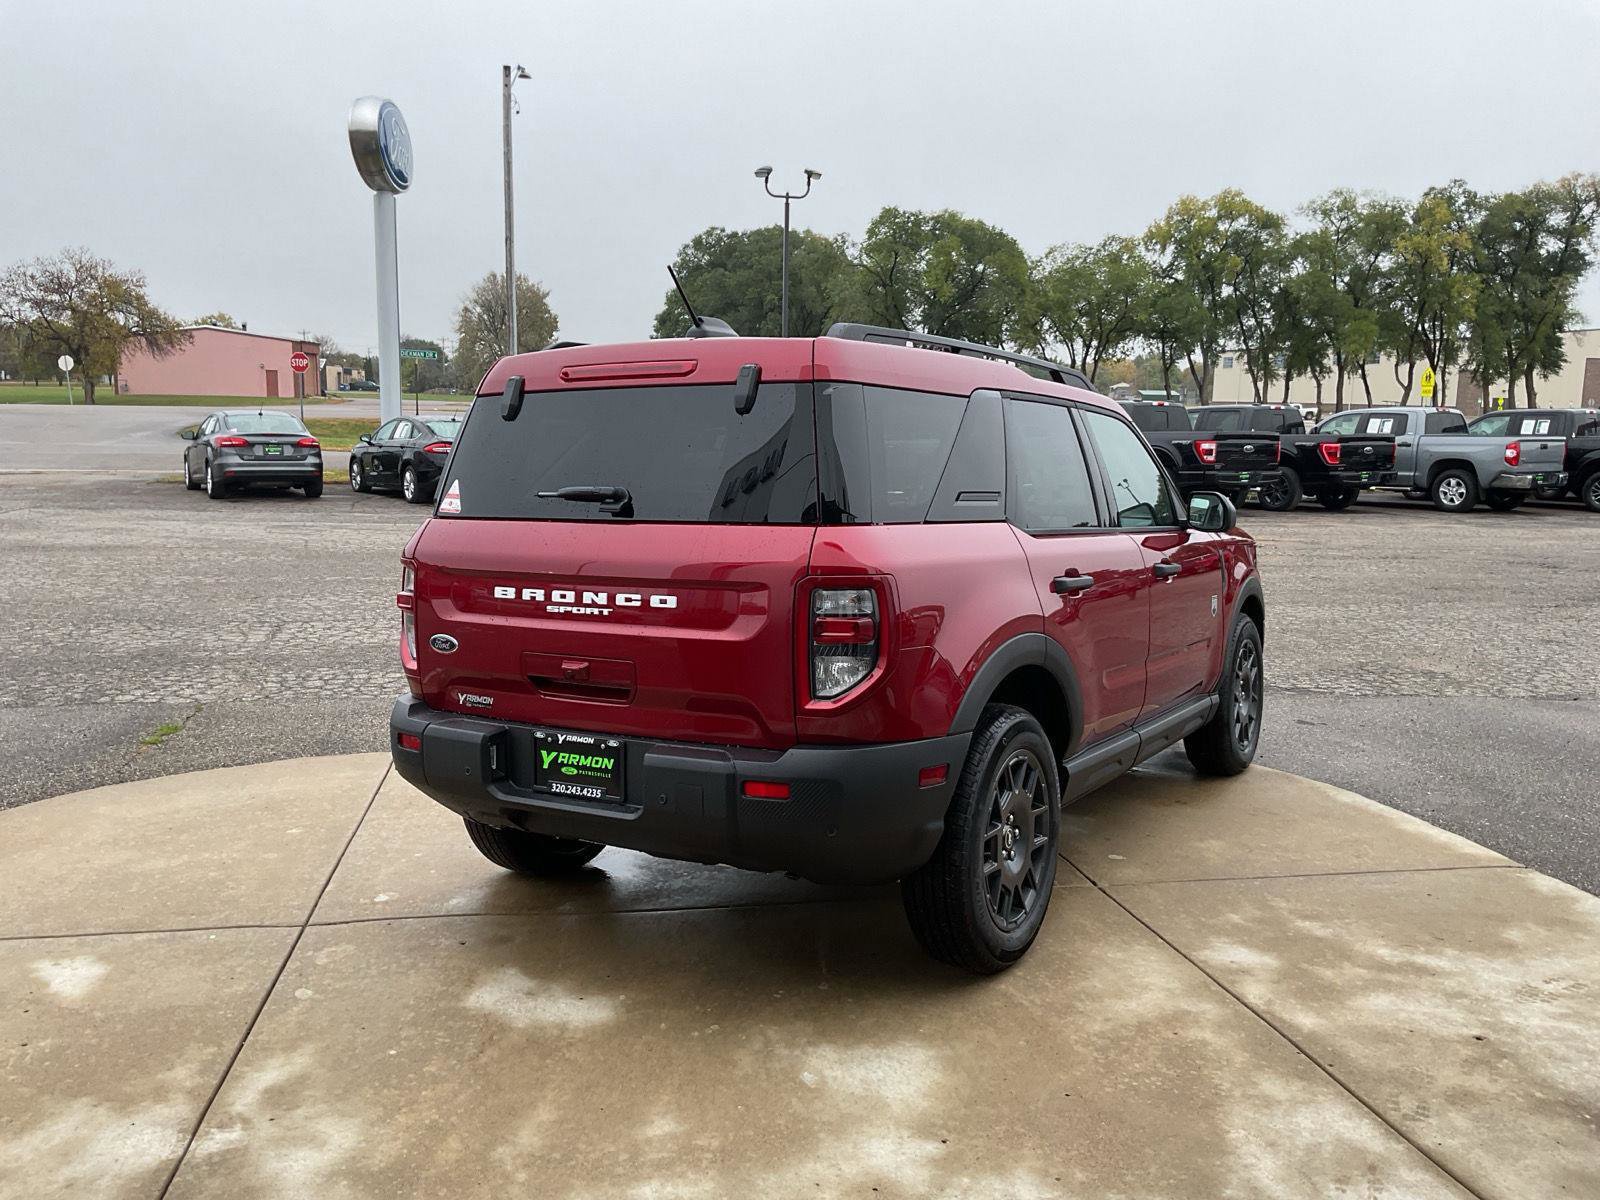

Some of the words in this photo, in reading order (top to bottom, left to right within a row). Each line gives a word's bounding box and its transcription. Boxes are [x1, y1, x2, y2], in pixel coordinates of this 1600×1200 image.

[291, 358, 308, 367] STOP
[494, 586, 678, 609] BRONCO
[546, 605, 613, 616] SPORT
[457, 692, 494, 705] YARMON
[556, 733, 595, 745] YARMON
[540, 750, 615, 770] YARMON
[551, 783, 602, 798] 320.243.4235
